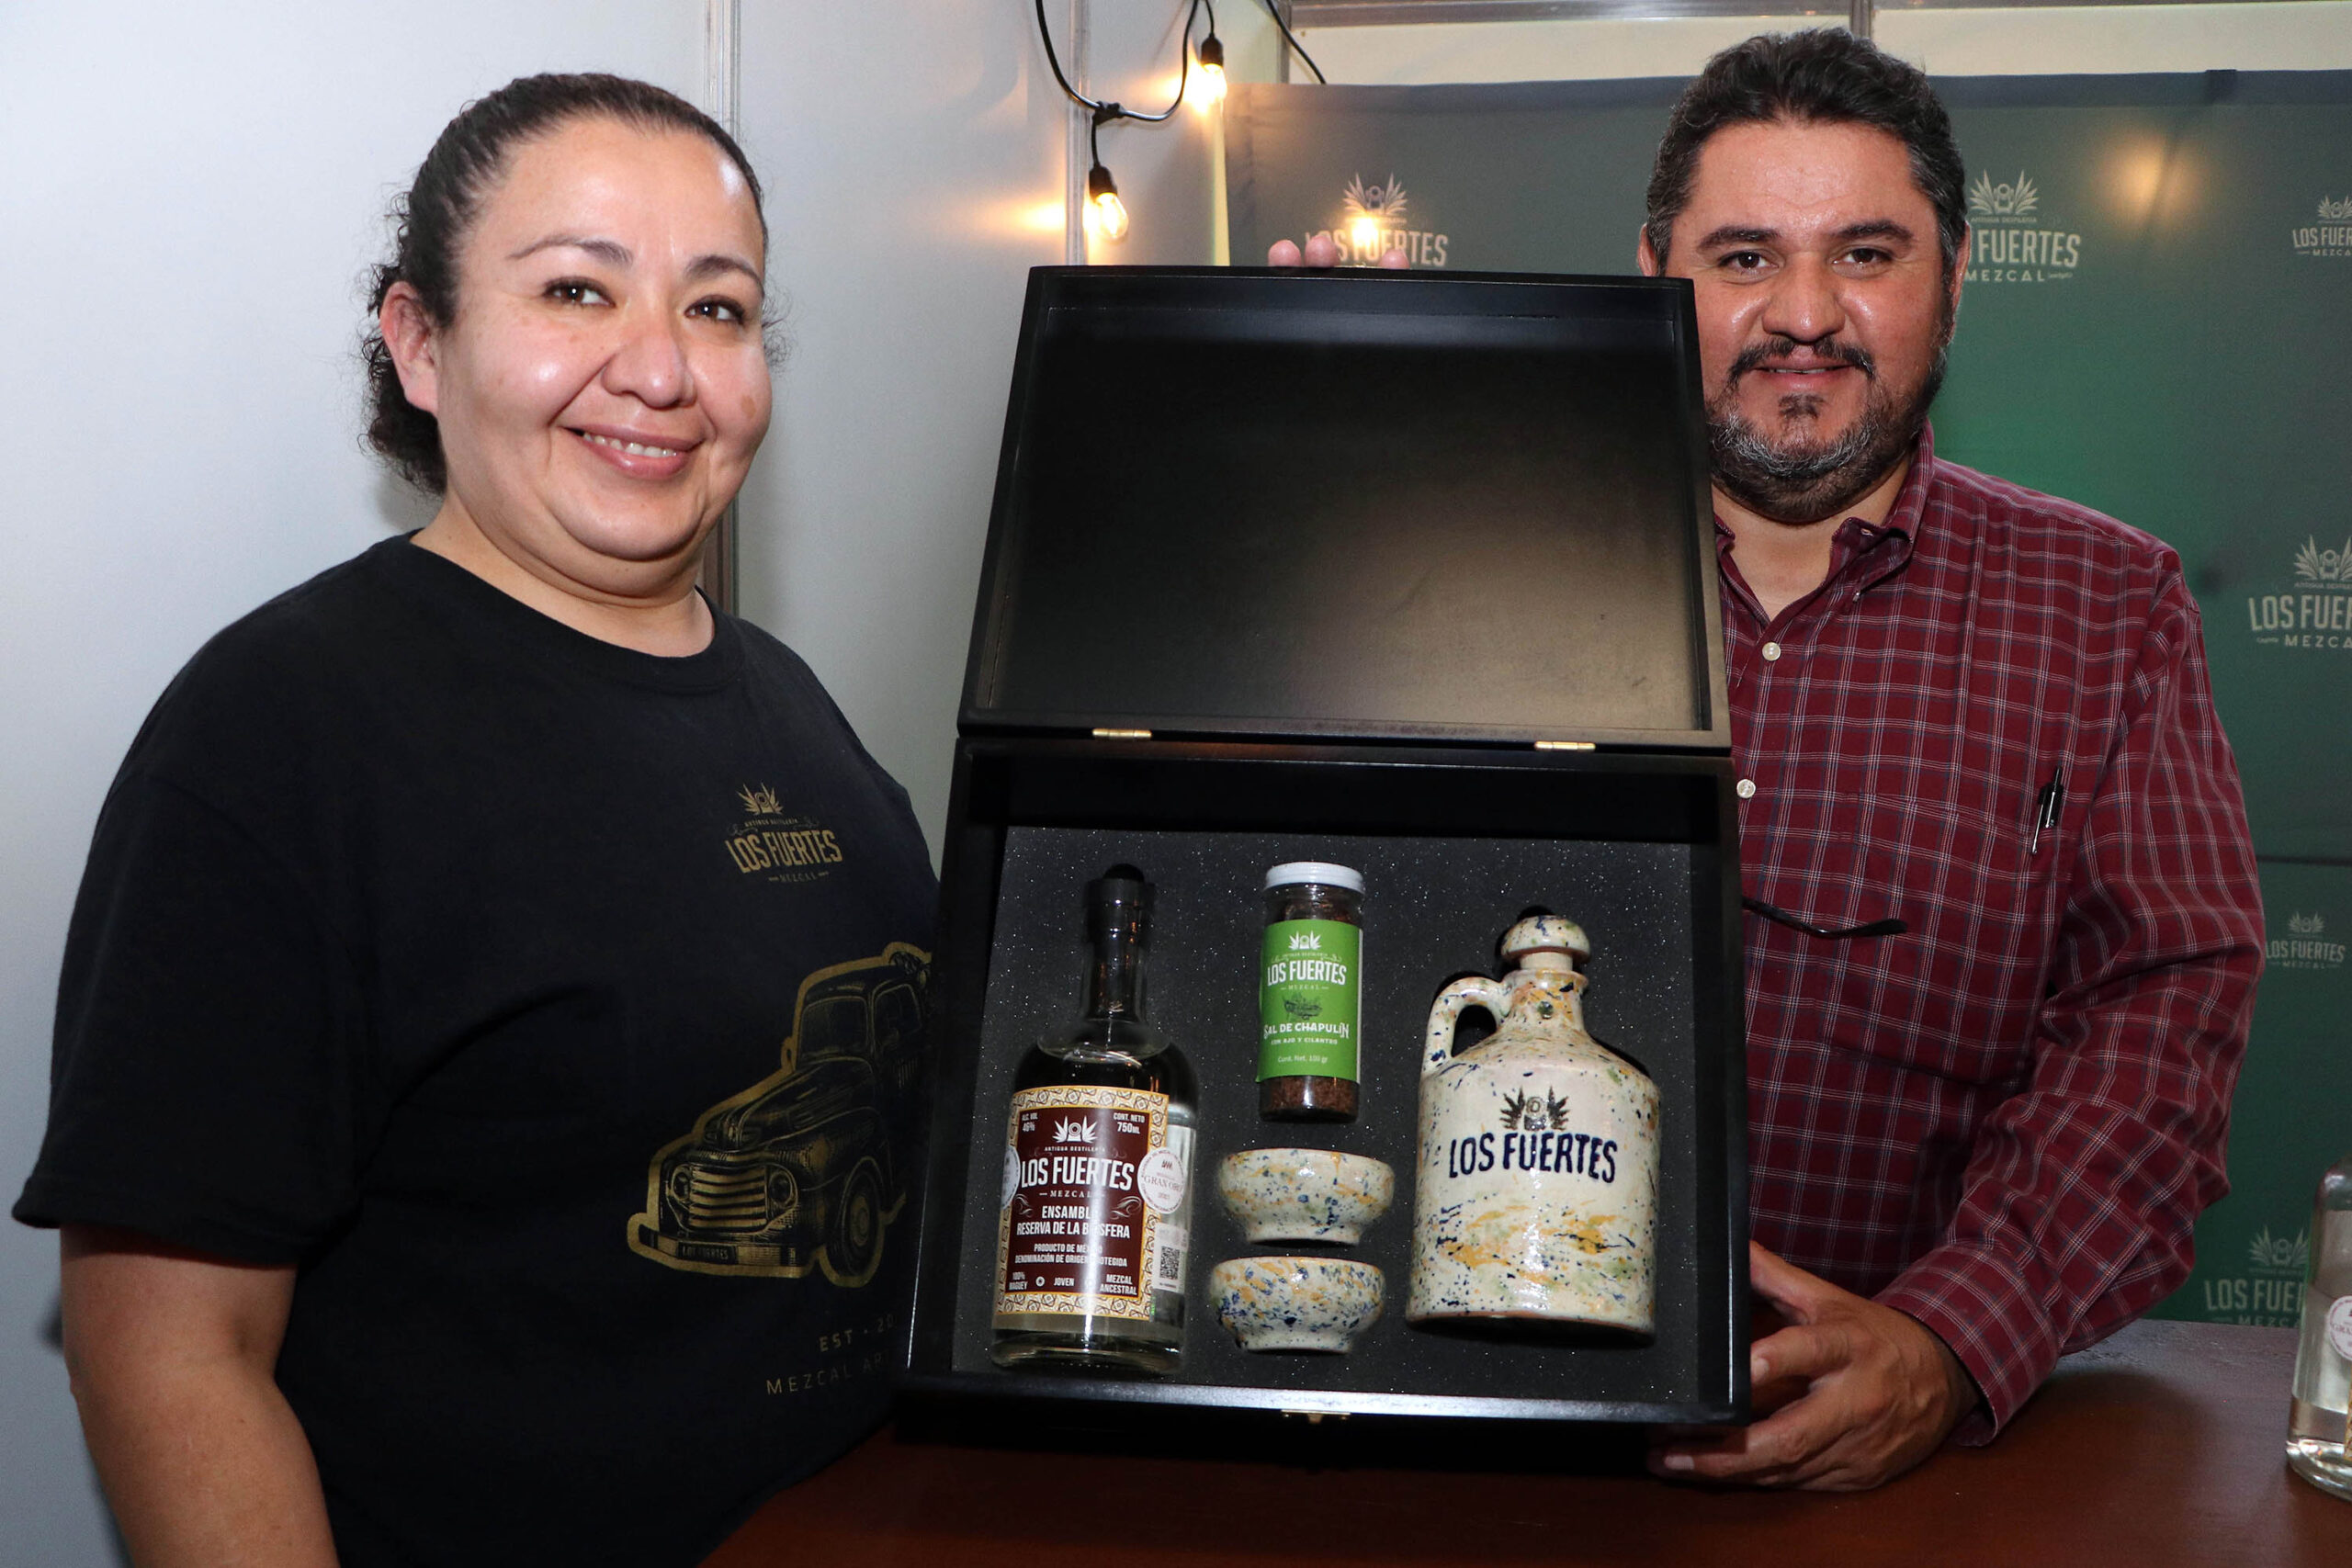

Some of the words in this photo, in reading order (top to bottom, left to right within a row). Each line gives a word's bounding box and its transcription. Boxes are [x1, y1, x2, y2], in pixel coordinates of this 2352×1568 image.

[2292, 228, 2318, 248] LOS
[1977, 229, 2081, 268] FUERTES
[1964, 269, 2045, 282] MEZCAL
[2248, 595, 2295, 631] LOS
[2285, 634, 2352, 649] MEZCA
[725, 834, 772, 874] LOS
[762, 829, 843, 866] FUERTES
[2266, 941, 2289, 959] LOS
[2291, 941, 2346, 963] FUERTES
[1267, 963, 1286, 987] LOS
[1289, 960, 1347, 986] FUERTES
[1280, 1023, 1293, 1032] DE
[1304, 1037, 1338, 1045] CILANTRO
[1130, 1113, 1146, 1123] NETO
[1449, 1132, 1495, 1179] LOS
[1502, 1132, 1618, 1183] FUERTES
[1021, 1158, 1049, 1188] LOS
[1052, 1156, 1135, 1191] FUERTES
[1042, 1205, 1101, 1220] ENSAMBL
[1016, 1221, 1051, 1235] RESERVA
[1052, 1222, 1066, 1235] DE
[1067, 1222, 1080, 1235] LA
[1082, 1223, 1130, 1239] BSFERA
[1034, 1243, 1066, 1253] PRODUCTO
[1066, 1244, 1076, 1253] DE
[1077, 1244, 1102, 1254] MEO
[1014, 1254, 1055, 1264] DENOMINACIÓN
[1056, 1254, 1066, 1263] DE
[1091, 1256, 1127, 1268] OTEGIDA
[1053, 1277, 1075, 1287] JOVEN
[1106, 1274, 1133, 1285] MEZCAL
[1099, 1284, 1137, 1295] ANCESTRAL
[2205, 1279, 2249, 1311] LOS
[819, 1328, 854, 1352] EST
[765, 1363, 853, 1395] MEZCAL
